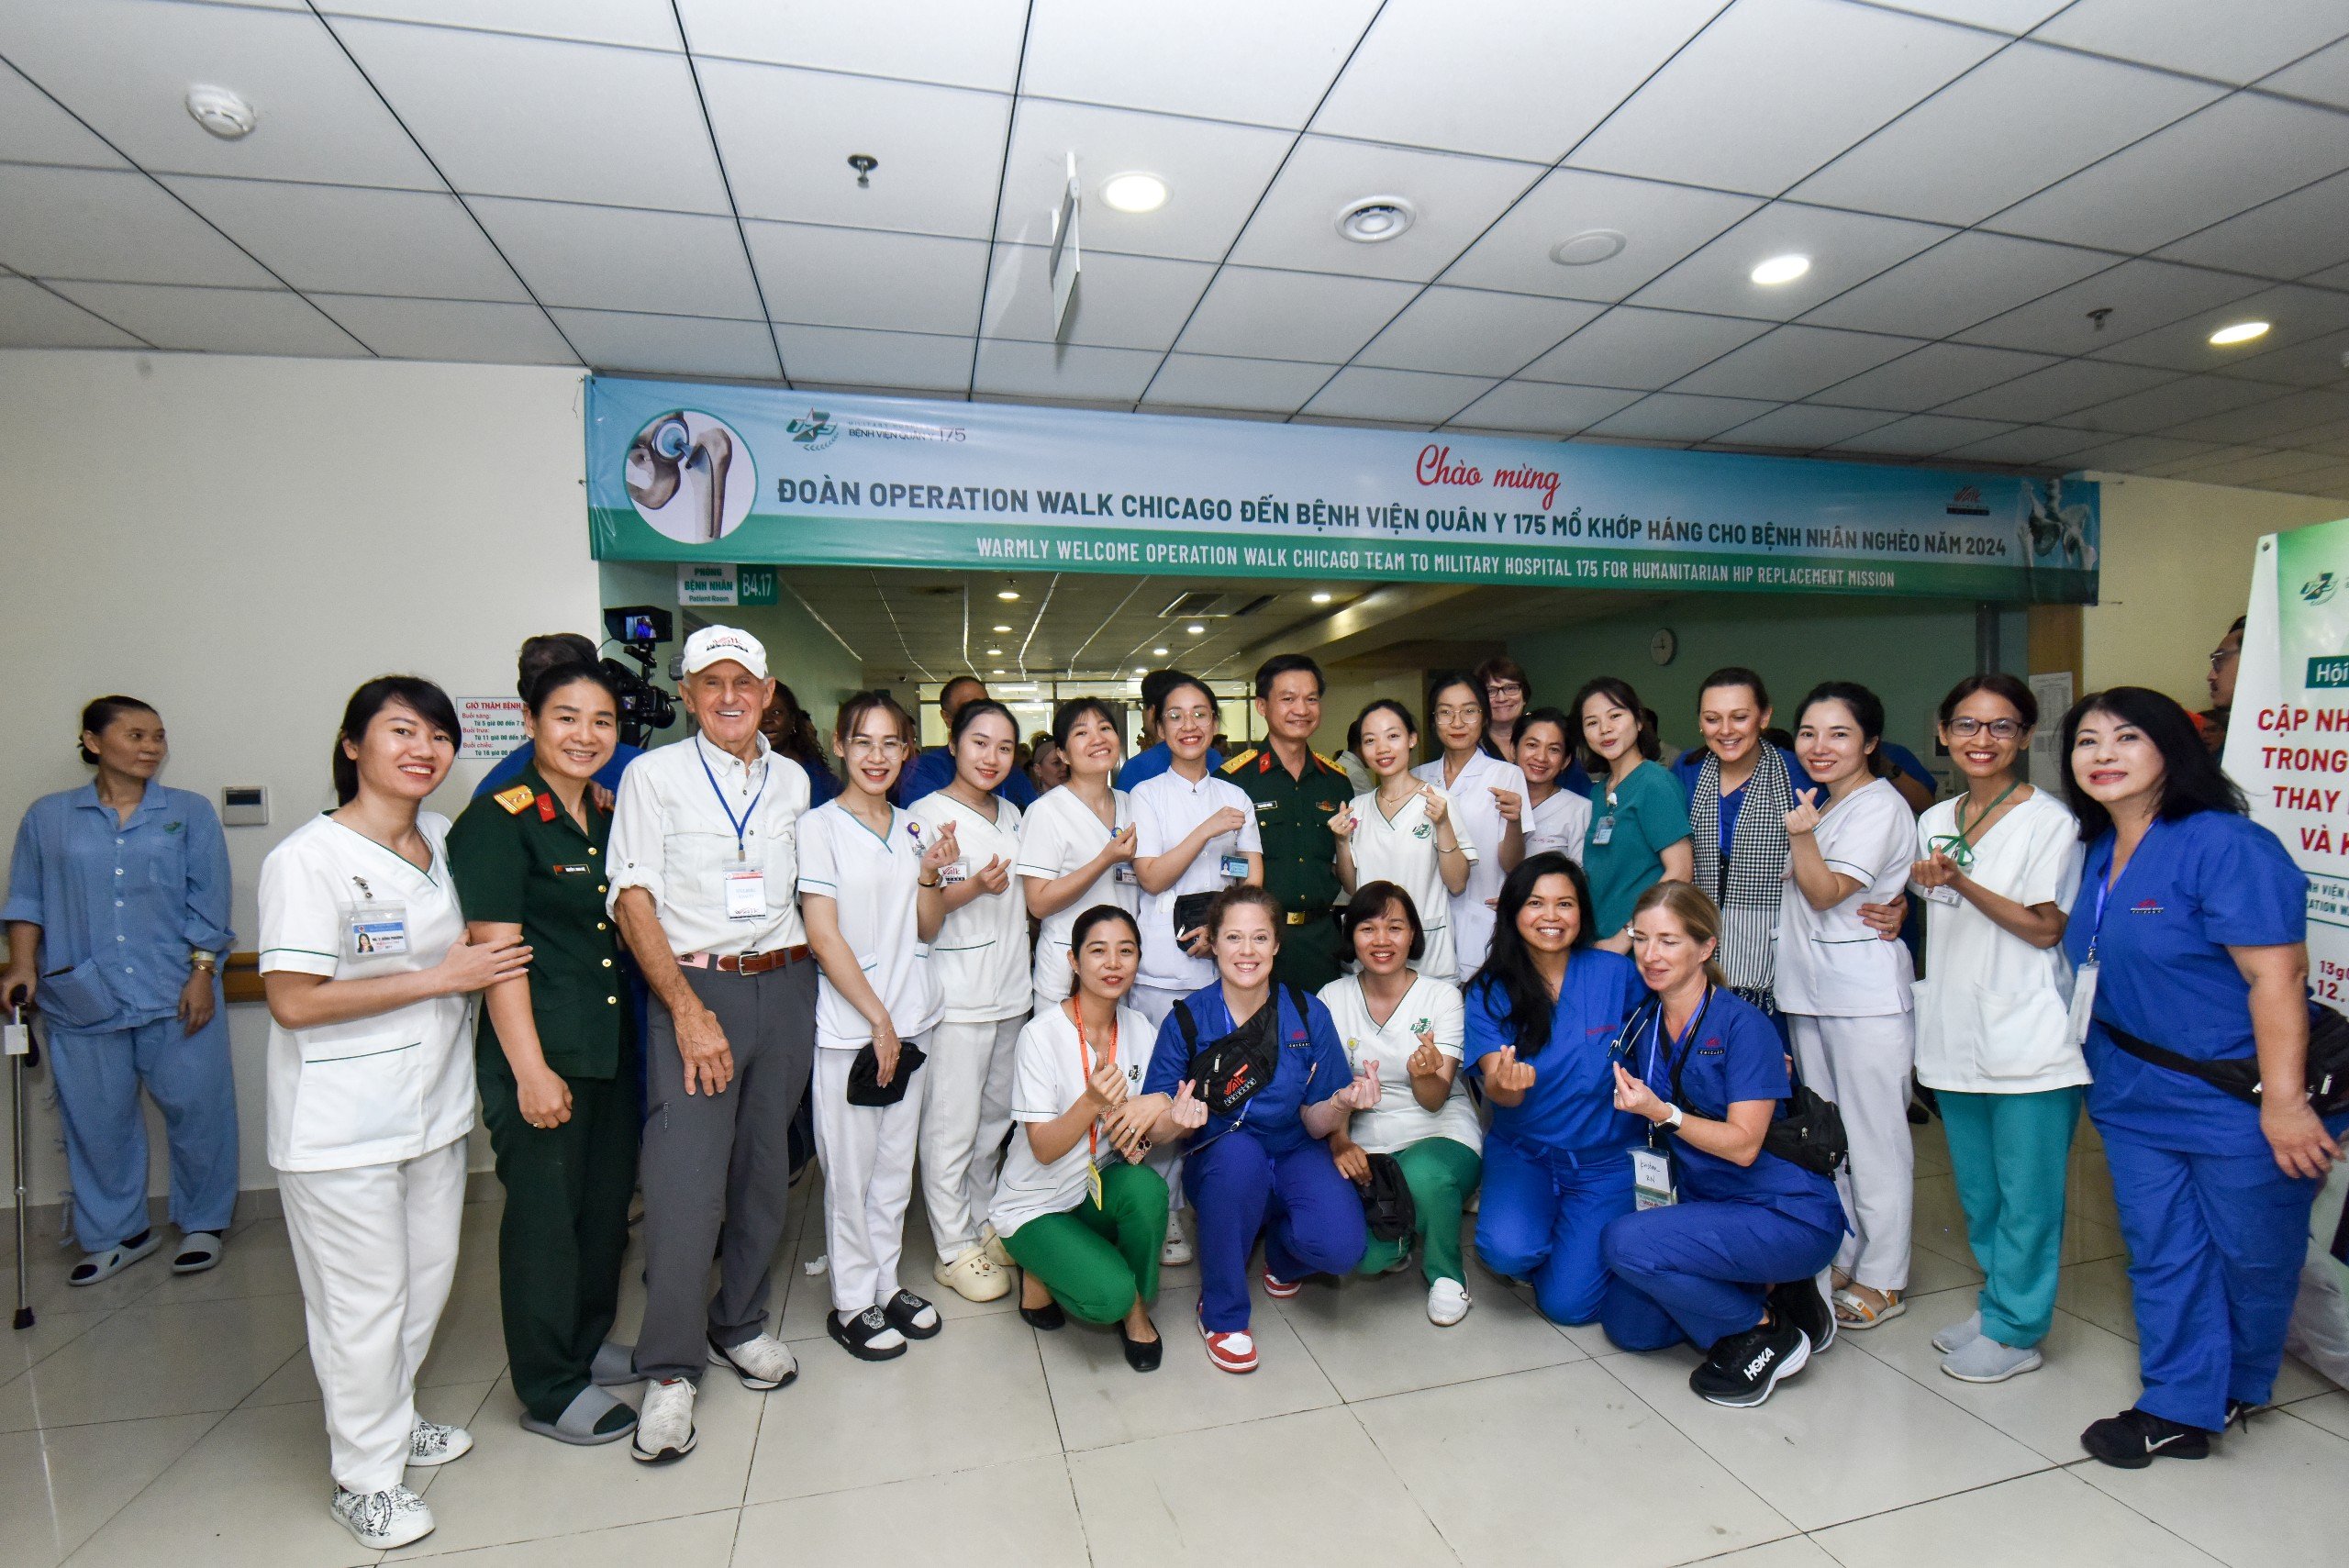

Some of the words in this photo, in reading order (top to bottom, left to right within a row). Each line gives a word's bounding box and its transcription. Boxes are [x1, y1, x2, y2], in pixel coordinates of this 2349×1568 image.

[849, 428, 875, 439] BỆNH
[876, 429, 897, 439] VIỆN
[1416, 444, 1483, 486] Chào
[1494, 462, 1562, 510] mừng
[777, 473, 861, 506] ĐOÀN
[870, 482, 1028, 514] OPERATION
[1037, 490, 1114, 517] WALK
[1121, 494, 1233, 522] CHICAGO
[1240, 494, 1289, 524] ĐẾN
[1296, 498, 1359, 532] BỆNH
[1366, 502, 1419, 536] VIỆN
[1426, 505, 1487, 535] QUÂN
[1494, 513, 1508, 534] Y
[1513, 513, 1546, 536] 175
[1553, 506, 1581, 538] MỔ
[1587, 514, 1642, 539] KHỚP
[1648, 516, 1703, 542] HÁNG
[1709, 523, 1745, 545] CHO
[1752, 521, 1801, 550] BỆNH
[1806, 527, 1857, 550] NHÂN
[1862, 529, 1920, 552] NGHÈO
[1924, 531, 1961, 554] NĂM
[1966, 537, 2007, 557] 2024
[695, 566, 722, 576] PHÒNG
[976, 537, 1050, 560] WARMLY
[1057, 540, 1140, 562] WELCOME
[1147, 543, 1238, 565] OPERATION
[1244, 548, 1287, 567] WALK
[1293, 550, 1359, 570] CHICAGO
[1364, 551, 1405, 572] TEAM
[1411, 554, 1429, 572] TO
[1434, 554, 1500, 574] MILITARY
[1505, 557, 1572, 577] HOSPITAL
[1576, 560, 1598, 578] 175
[1603, 561, 1628, 579] FOR
[1633, 562, 1729, 582] HUMANITARIAN
[1733, 565, 1753, 583] HIP
[1758, 566, 1843, 586] REPLACEMENT
[1848, 569, 1895, 588] MISSION
[685, 580, 707, 593] BỆNH
[709, 580, 733, 591] NHÂN
[742, 573, 773, 597] B4.17
[2316, 662, 2349, 686] Hội
[503, 701, 521, 710] BỆNH
[2257, 704, 2309, 738] CẬP
[2261, 747, 2349, 773] TRONG
[2272, 785, 2341, 813] THAY
[2300, 824, 2332, 853] VÀ
[2322, 884, 2345, 899] VIỆN
[1743, 1347, 1776, 1382] HOKA
